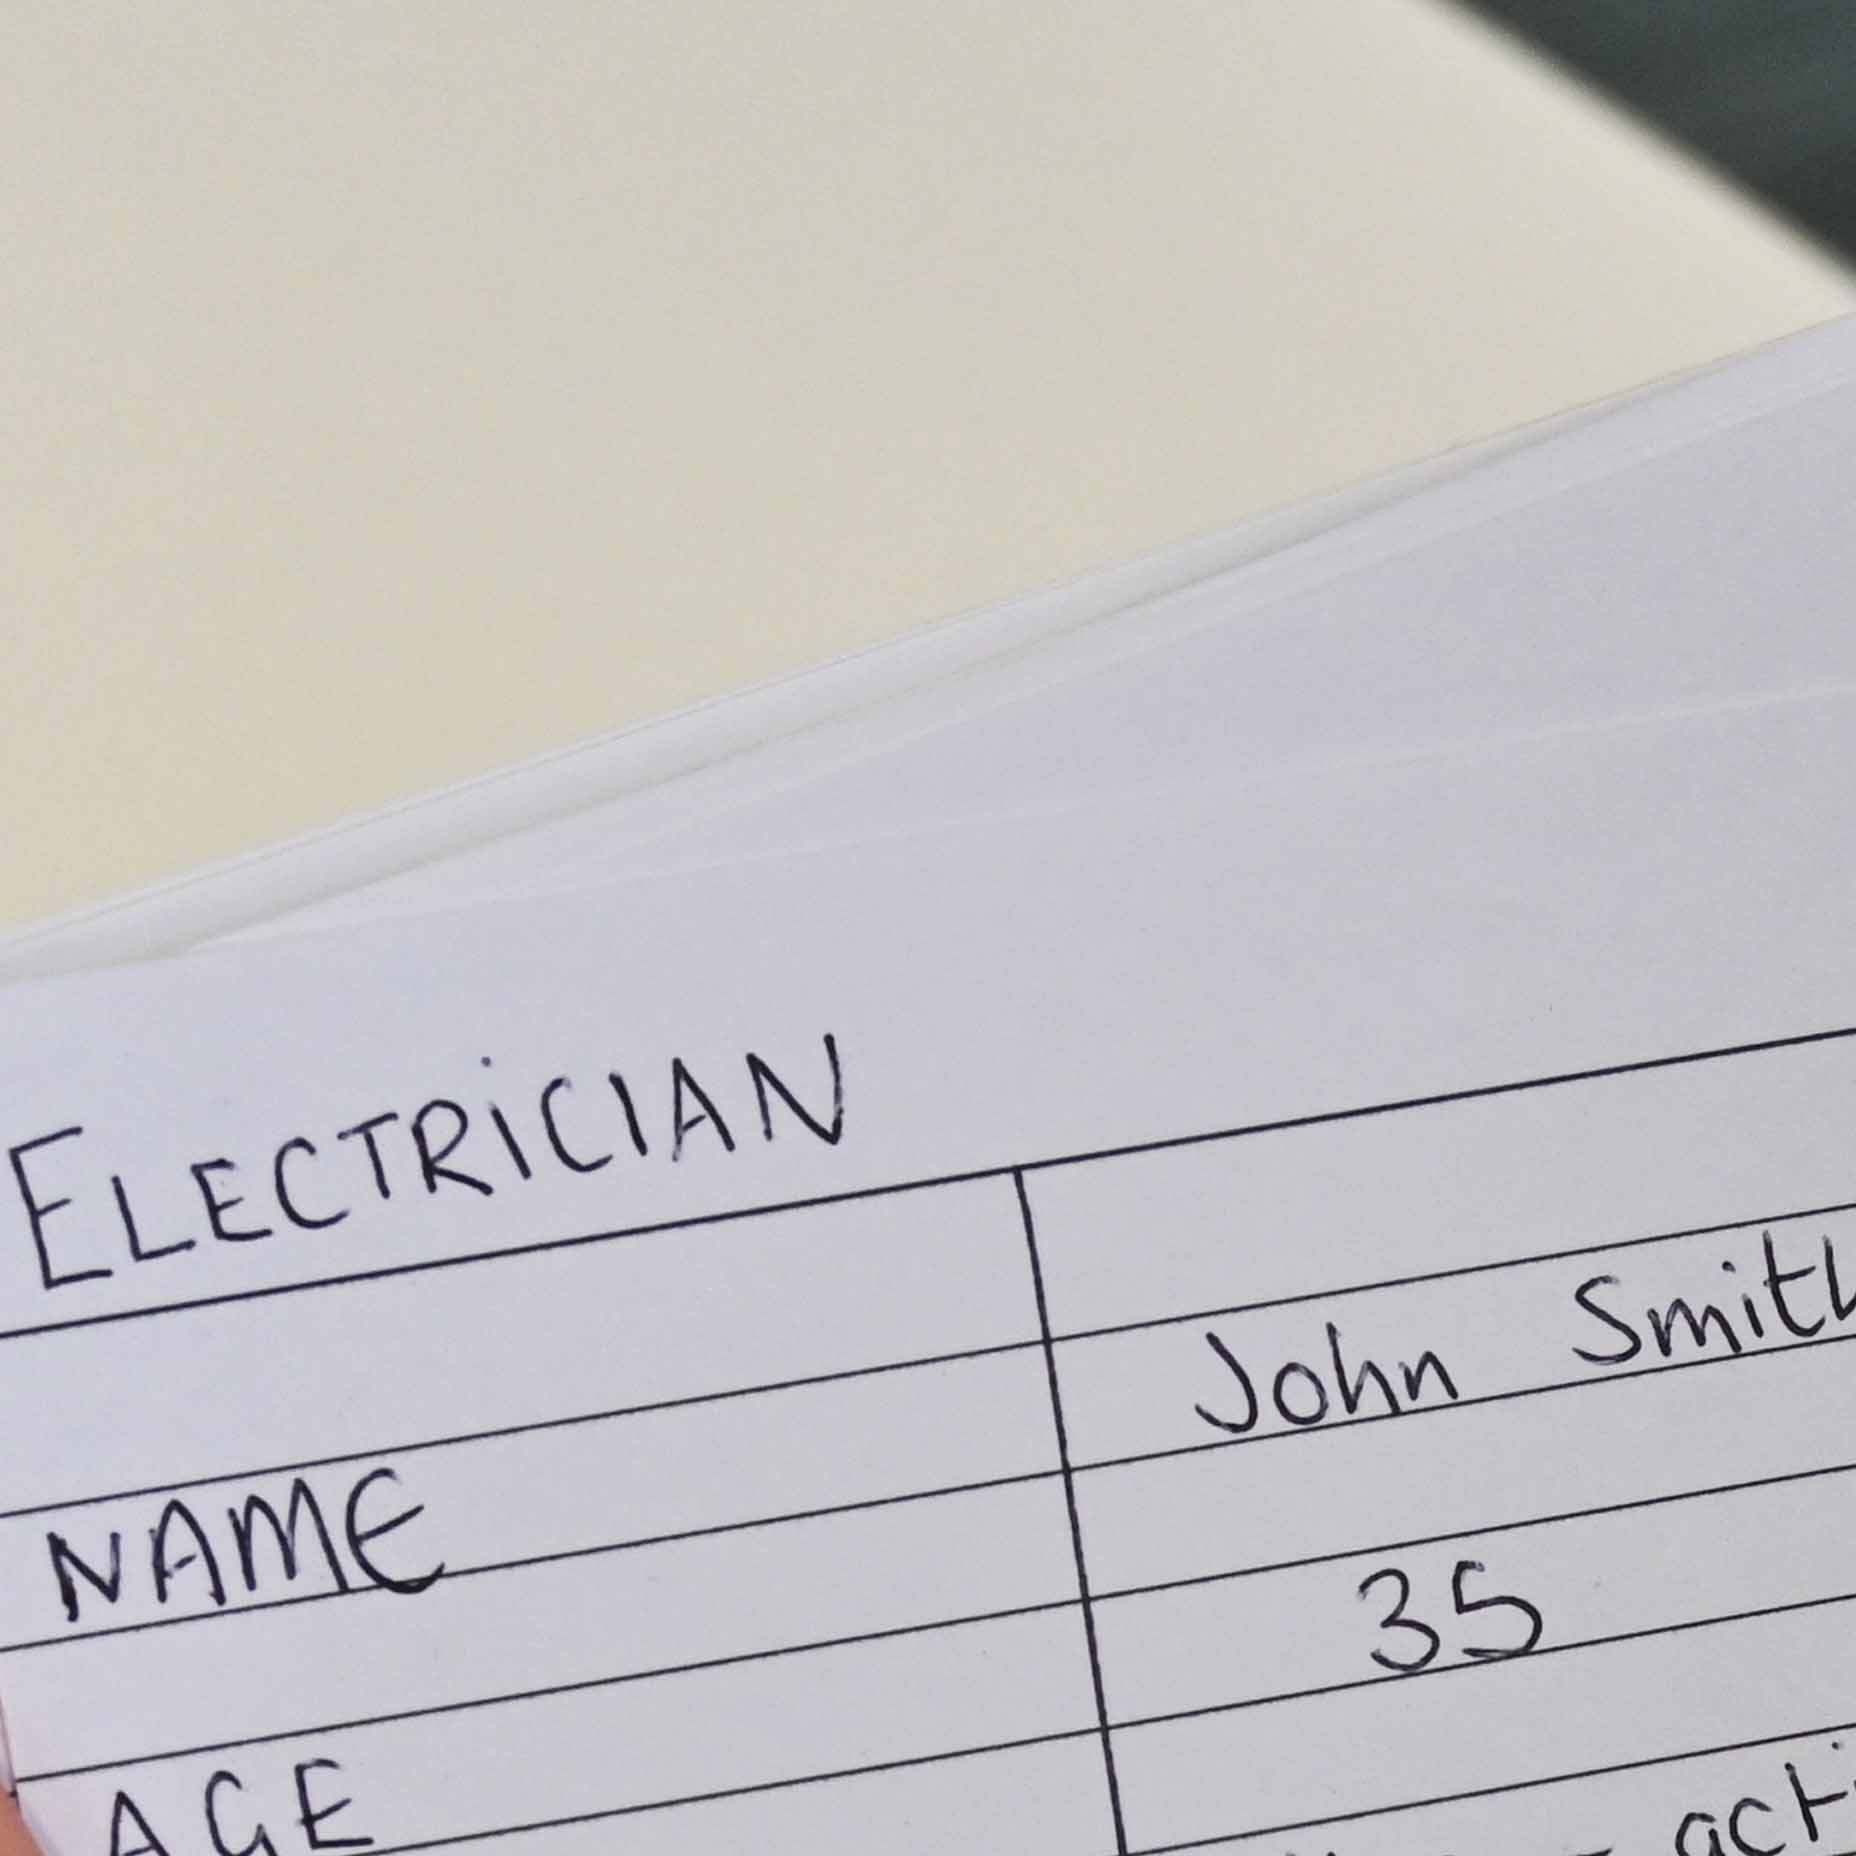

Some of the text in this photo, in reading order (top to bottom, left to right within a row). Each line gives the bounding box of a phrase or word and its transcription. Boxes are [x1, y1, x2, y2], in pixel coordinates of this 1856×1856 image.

[1194, 1322, 1459, 1433] John
[47, 1466, 447, 1623] NAME
[1357, 1559, 1544, 1673] 35
